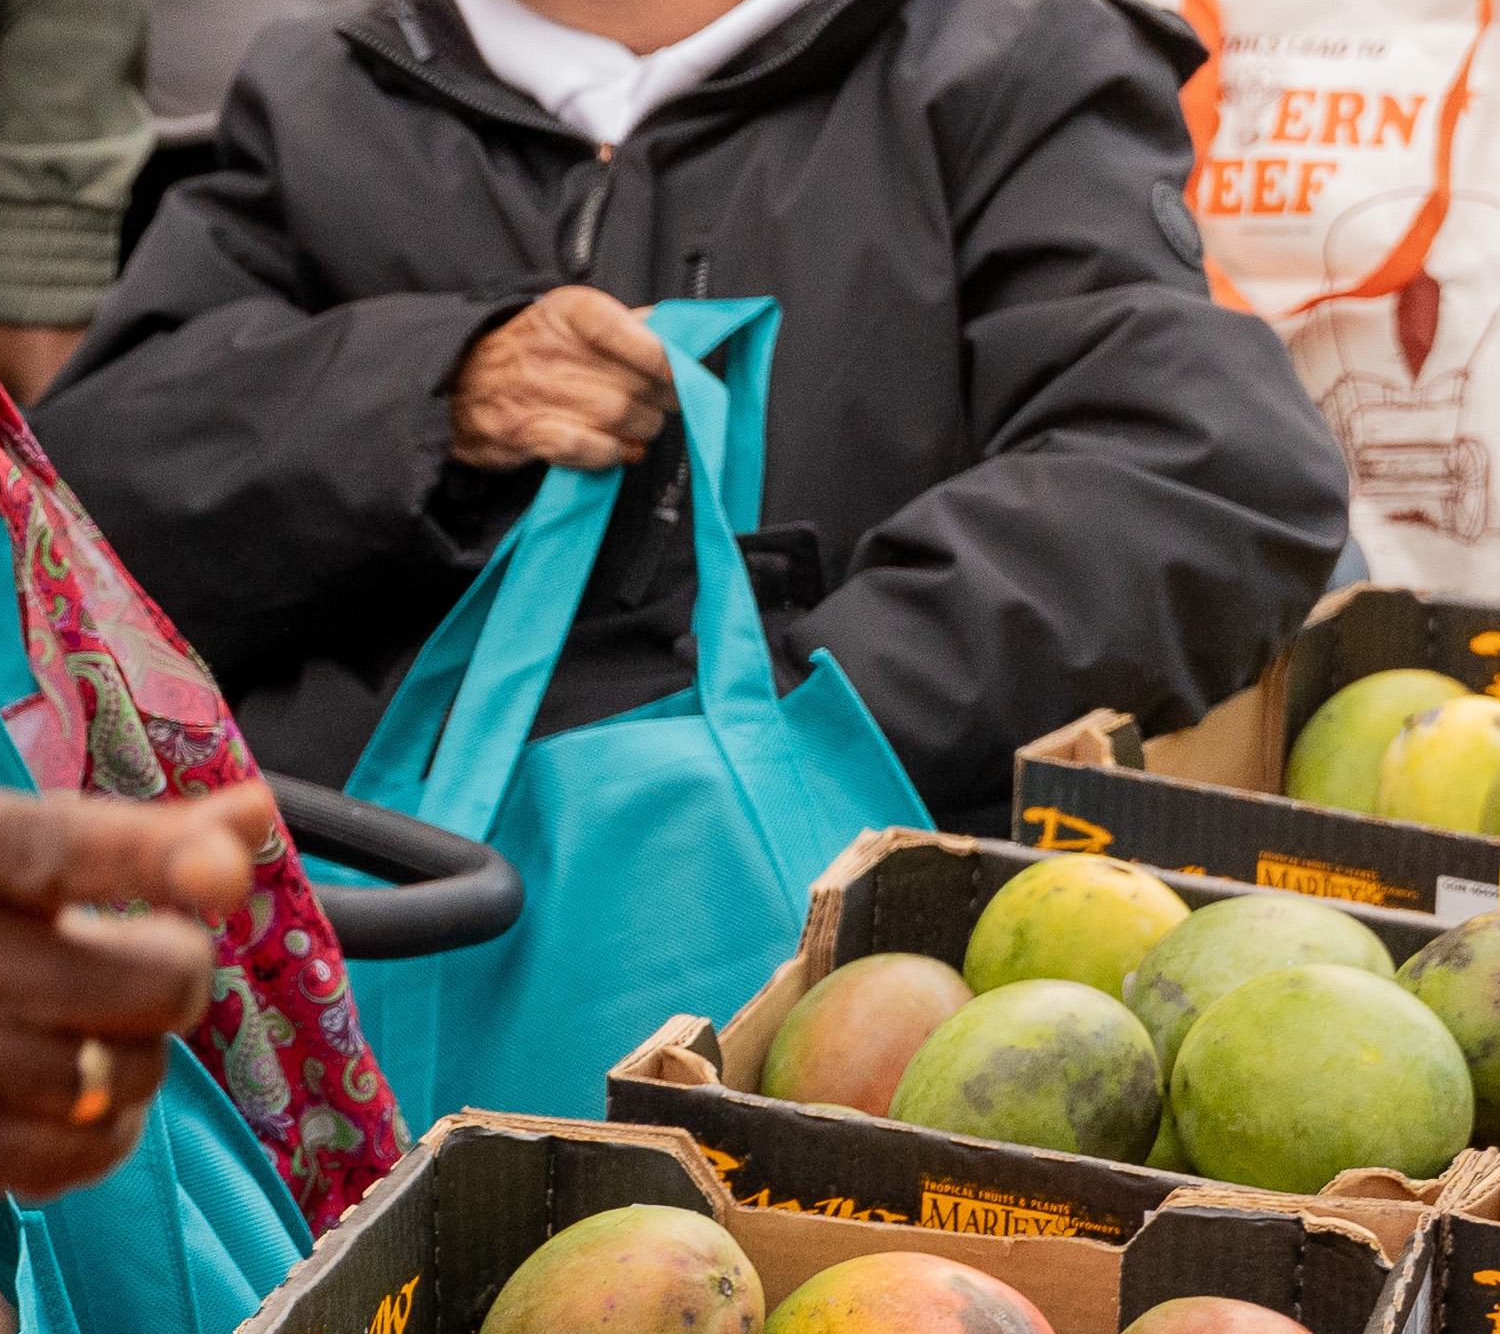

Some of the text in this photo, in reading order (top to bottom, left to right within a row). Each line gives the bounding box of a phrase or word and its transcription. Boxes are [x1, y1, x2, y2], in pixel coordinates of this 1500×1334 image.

[1208, 158, 1338, 215] EEF
[924, 1180, 975, 1197] TROPICAL
[978, 1189, 1015, 1205] FRUITS
[1030, 1198, 1072, 1215] PLANTS
